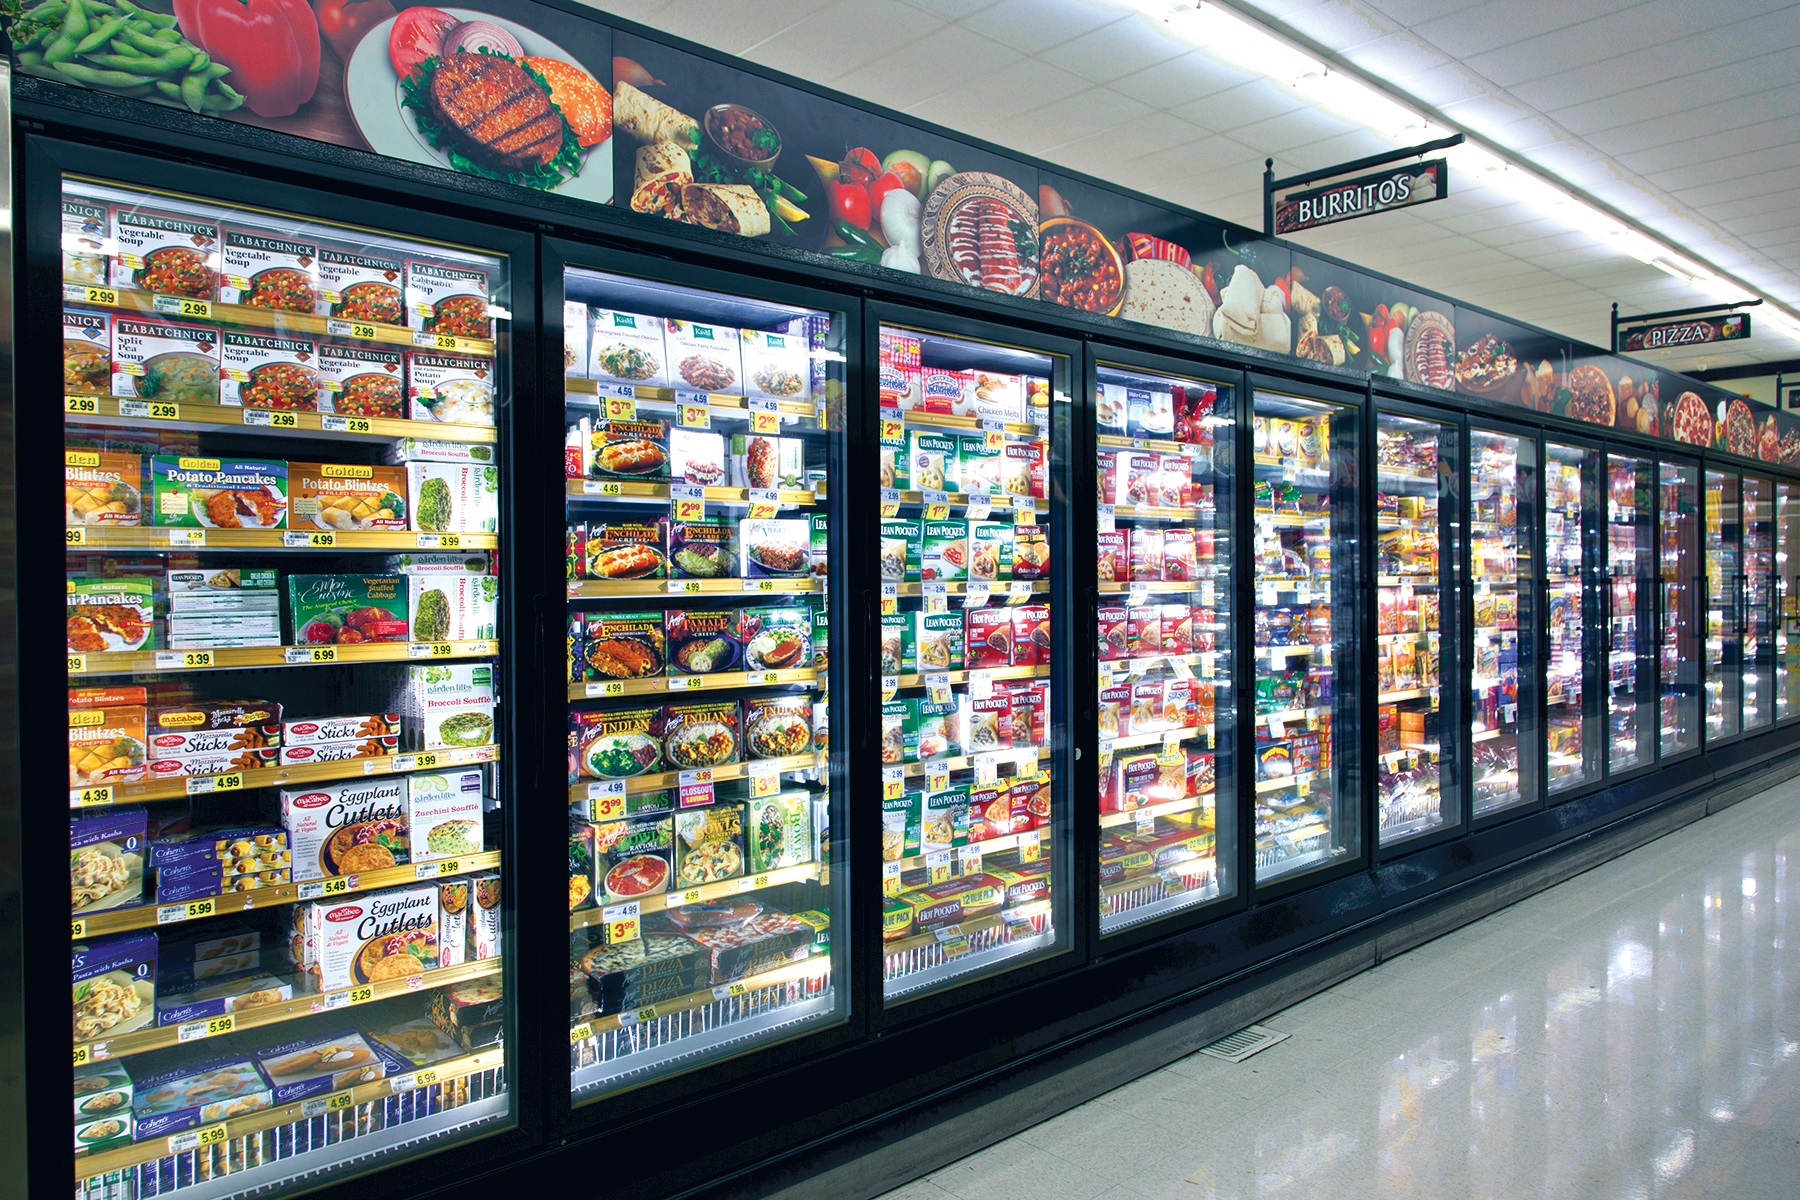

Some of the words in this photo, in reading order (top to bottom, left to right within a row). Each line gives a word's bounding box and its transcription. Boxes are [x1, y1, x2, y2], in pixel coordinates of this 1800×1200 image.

[1299, 176, 1410, 222] BURRITOS
[122, 213, 214, 236] TABATCHNICK
[118, 227, 165, 241] Vegetable
[118, 236, 144, 246] Soup
[231, 235, 312, 255] TABATCHNICK
[225, 249, 271, 262] Vegetable
[225, 257, 250, 268] Soup
[90, 290, 114, 303] 2.99
[184, 303, 207, 315] 2.99
[123, 323, 213, 342] TABATCHNICK
[354, 326, 374, 337] 2.99
[1652, 326, 1704, 346] PIZZA
[118, 336, 143, 345] Split
[228, 335, 310, 351] TABATCHNICK
[438, 338, 456, 348] 2.99
[118, 344, 137, 352] Pea
[224, 347, 269, 357] Vegetable
[118, 352, 144, 361] Soup
[224, 354, 248, 363] Soup
[323, 347, 398, 363] TABATCHNICK
[319, 358, 360, 368] Vegetable
[417, 356, 487, 370] TABATCHNICK
[319, 366, 341, 374] Soup
[617, 386, 632, 396] 4.59
[693, 394, 707, 403] 4.59
[69, 400, 94, 411] 2.99
[152, 405, 175, 417] 2.99
[765, 402, 777, 410] 4.59
[892, 411, 903, 419] 3.49
[978, 406, 1003, 415] Chicken
[1004, 408, 1019, 418] Melts
[273, 415, 295, 426] 2.99
[994, 422, 1003, 430] 5.99
[349, 422, 369, 431] 2.99
[609, 422, 665, 439] ENCHILADA
[920, 438, 933, 448] LEAN
[934, 439, 954, 449] POCKETS
[963, 442, 976, 452] LEAN
[1007, 446, 1020, 457] HOT
[1020, 447, 1040, 458] POCKETS
[182, 459, 219, 469] Golden
[66, 468, 120, 482] Blintzes
[167, 470, 214, 482] Potato
[216, 472, 276, 485] Pancakes
[324, 467, 370, 477] Golden
[302, 478, 340, 490] Potato
[345, 479, 389, 492] Blintzes
[604, 484, 619, 494] 4.49
[688, 488, 702, 497] 4.99
[765, 491, 777, 500] 4.99
[888, 492, 899, 500] 2.99
[604, 530, 660, 542] ENCHILADA
[684, 527, 732, 539] ENCHILADA
[881, 526, 893, 535] LEAN
[893, 526, 918, 536] POCKETS
[927, 526, 941, 536] LEAN
[942, 526, 965, 536] POCKETS
[312, 536, 333, 544] 4.99
[442, 537, 459, 546] 3.99
[686, 583, 699, 592] 4.99
[885, 586, 896, 594] 2.99
[79, 592, 142, 605] Pancakes
[367, 591, 397, 600] Cabbage
[926, 618, 938, 627] LEAN
[939, 617, 962, 627] POCKETS
[972, 613, 985, 623] HOT
[683, 618, 728, 631] TAMALE
[601, 624, 656, 637] ENCHILADA
[314, 650, 334, 660] 6.99
[433, 645, 450, 655] 3.99
[187, 654, 209, 665] 3.39
[687, 678, 701, 687] 4.99
[764, 673, 777, 681] 4.99
[606, 684, 621, 692] 4.99
[885, 679, 896, 688] 2.99
[428, 698, 461, 707] Broccoli
[462, 696, 491, 704] Soufflé
[974, 701, 985, 710] HOT
[986, 699, 1008, 709] POCKETS
[683, 710, 728, 727] INDIAN
[602, 718, 650, 735] INDIAN
[70, 726, 125, 740] Blintzes
[318, 726, 355, 740] Sticks
[185, 738, 227, 753] Sticks
[314, 750, 352, 762] Sticks
[418, 756, 436, 766] 3.99
[180, 764, 224, 776] Sticks
[938, 763, 948, 771] 2.99
[1138, 760, 1156, 771] POCKETS
[696, 772, 711, 781] 3.99
[892, 770, 903, 778] 2.99
[217, 777, 239, 787] 4.99
[608, 782, 623, 792] 4.99
[1022, 782, 1039, 792] POCKETS
[83, 789, 108, 802] 4.39
[339, 787, 401, 806] Eggplant
[682, 786, 713, 796] CLOSEOUT
[685, 794, 709, 804] SAVINGS
[930, 797, 943, 807] LEAN
[944, 791, 966, 805] POCKETS
[326, 802, 402, 828] Cutlets
[415, 807, 449, 817] Zucchini
[451, 804, 479, 812] Soufflé
[694, 819, 741, 841] BOWLS
[126, 836, 137, 849] 0
[617, 831, 670, 852] BOWLS
[629, 842, 658, 851] RAVIOLI
[156, 846, 184, 858] Cohen's
[163, 865, 192, 876] Cohen's
[441, 862, 458, 872] 3.99
[888, 864, 899, 873] 2.99
[162, 884, 190, 896] Cohen's
[326, 881, 346, 892] 5.49
[1010, 886, 1020, 896] HOT
[1020, 881, 1045, 894] POCKETS
[685, 891, 699, 900] 4.99
[189, 902, 212, 914] 5.99
[371, 898, 432, 918] Eggplant
[622, 905, 638, 915] 4.99
[920, 908, 933, 920] HOT
[934, 904, 959, 918] POCKETS
[896, 912, 910, 923] PACK
[357, 912, 433, 940] Cutlets
[328, 933, 349, 942] Natural
[753, 934, 793, 954] PIZZA
[137, 963, 148, 976] 0
[642, 958, 684, 980] PIZZA
[730, 984, 745, 994] 7.99
[352, 989, 371, 1001] 5.29
[163, 1006, 192, 1020] Cohen's
[638, 1008, 655, 1020] 6.99
[210, 1020, 231, 1032] 5.99
[417, 1072, 436, 1085] 6.99
[278, 1083, 305, 1097] Cohen's
[330, 1096, 351, 1108] 4.99
[138, 1115, 169, 1130] Cohen's
[201, 1129, 225, 1142] 5.99
